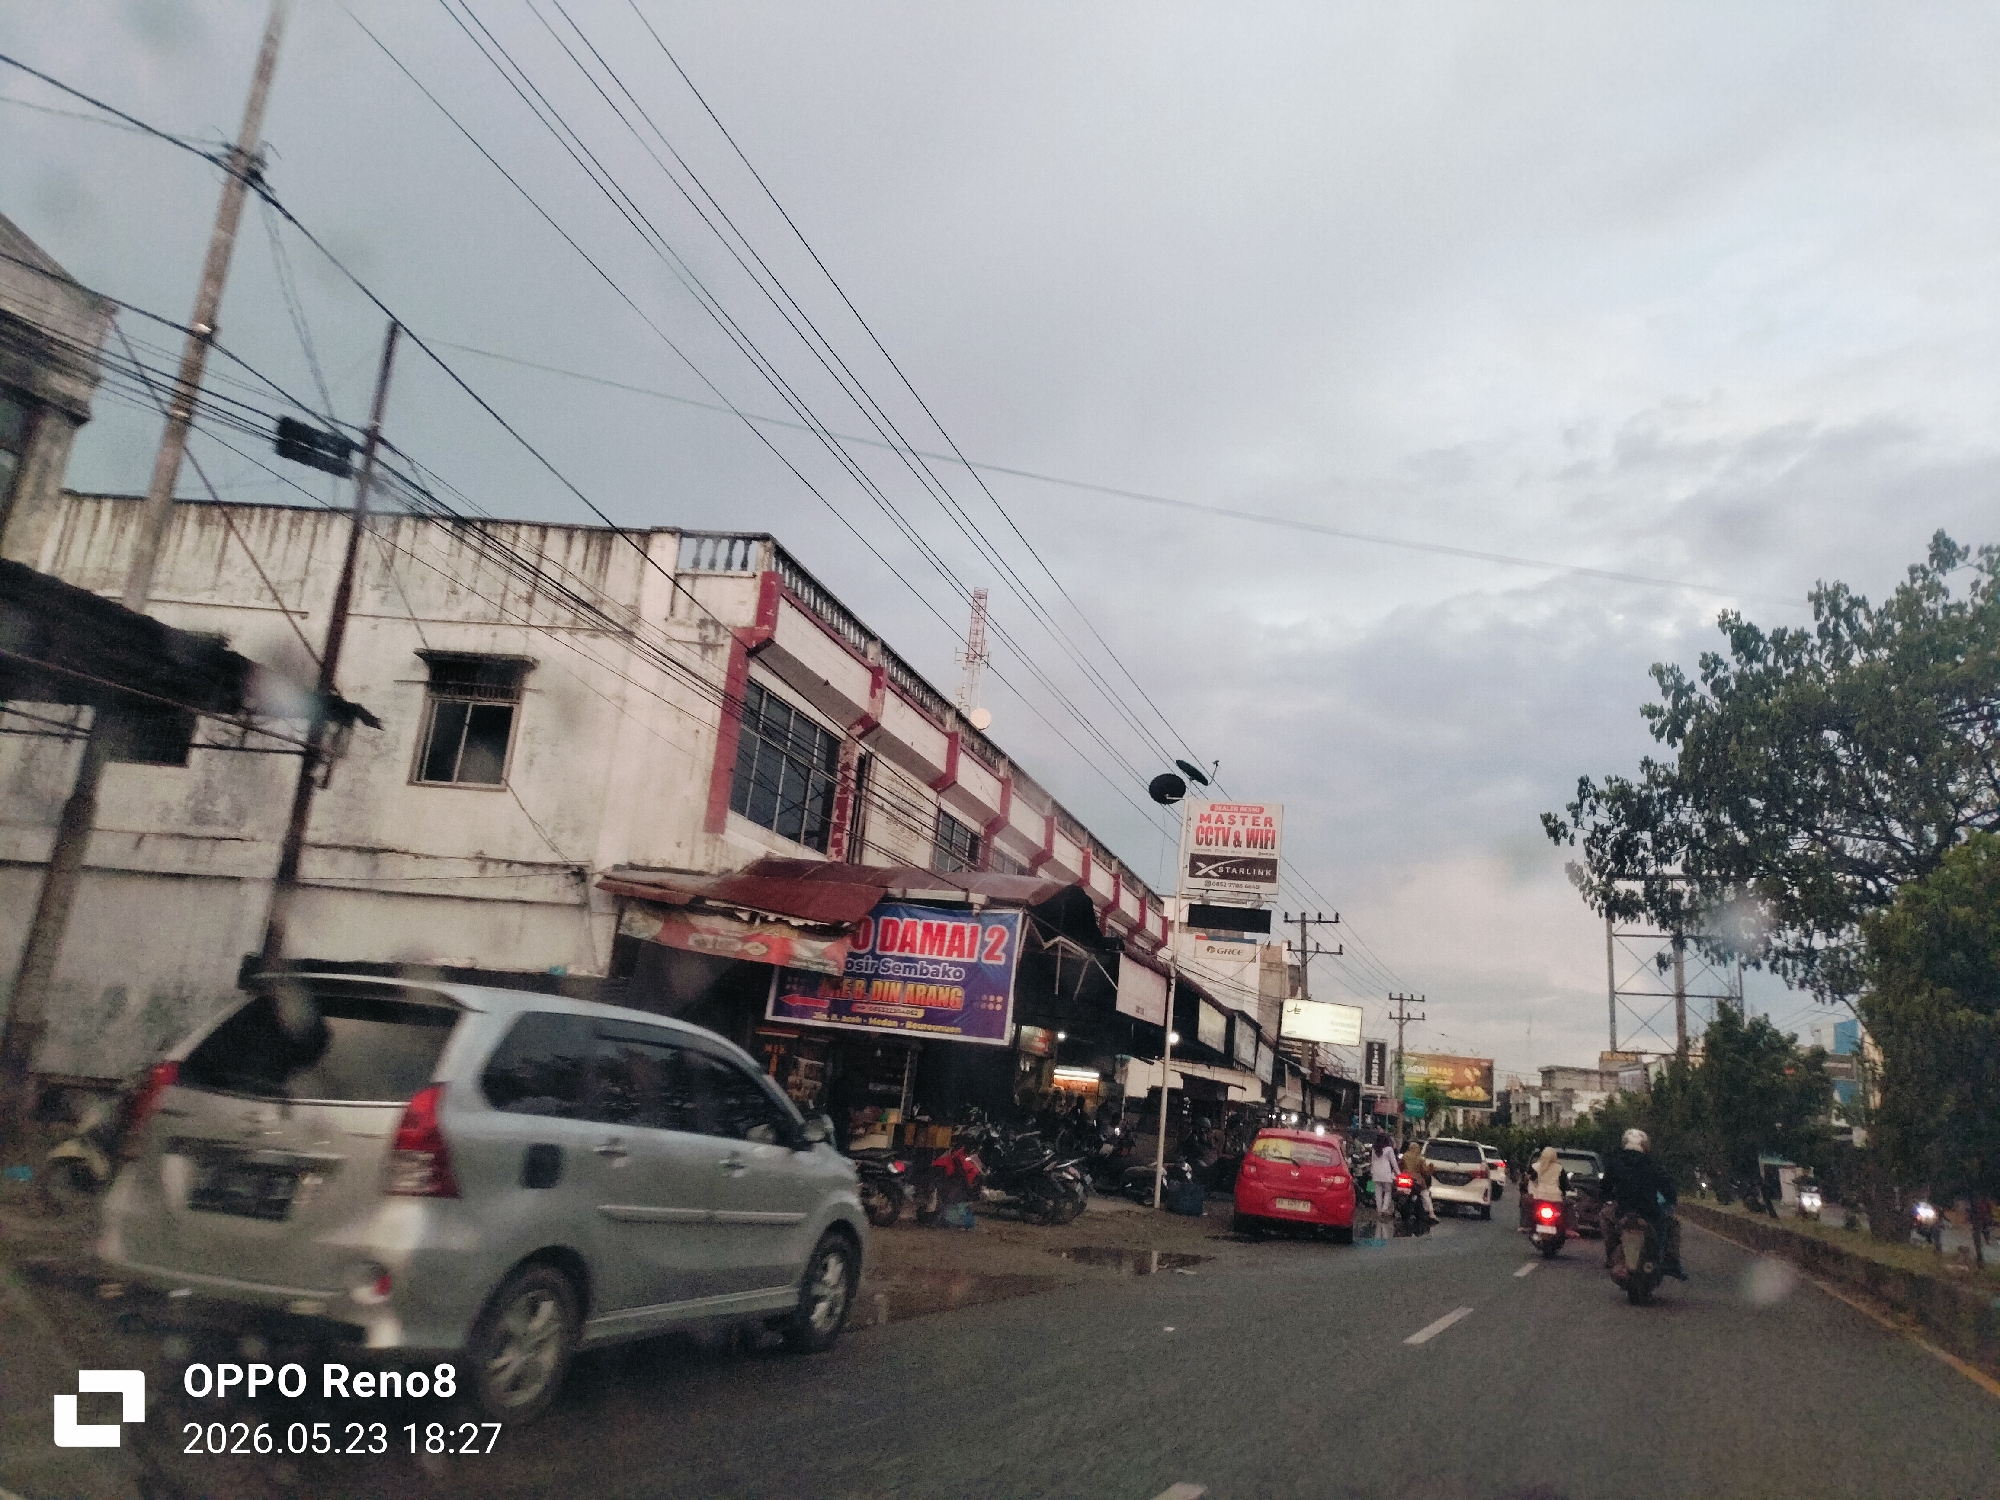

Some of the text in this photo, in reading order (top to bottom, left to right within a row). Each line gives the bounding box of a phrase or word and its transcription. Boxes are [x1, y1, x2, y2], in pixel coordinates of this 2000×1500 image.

[1199, 813, 1274, 828] MASTER
[1195, 826, 1276, 850] CCTV & WIFI
[1218, 866, 1272, 877] STARLINK
[877, 916, 981, 961] DAMAI
[982, 924, 1009, 964] 2
[879, 957, 965, 981] Sembako
[870, 978, 904, 1005] DIN
[904, 982, 964, 1010] ARANG
[869, 1017, 899, 1028] Medan
